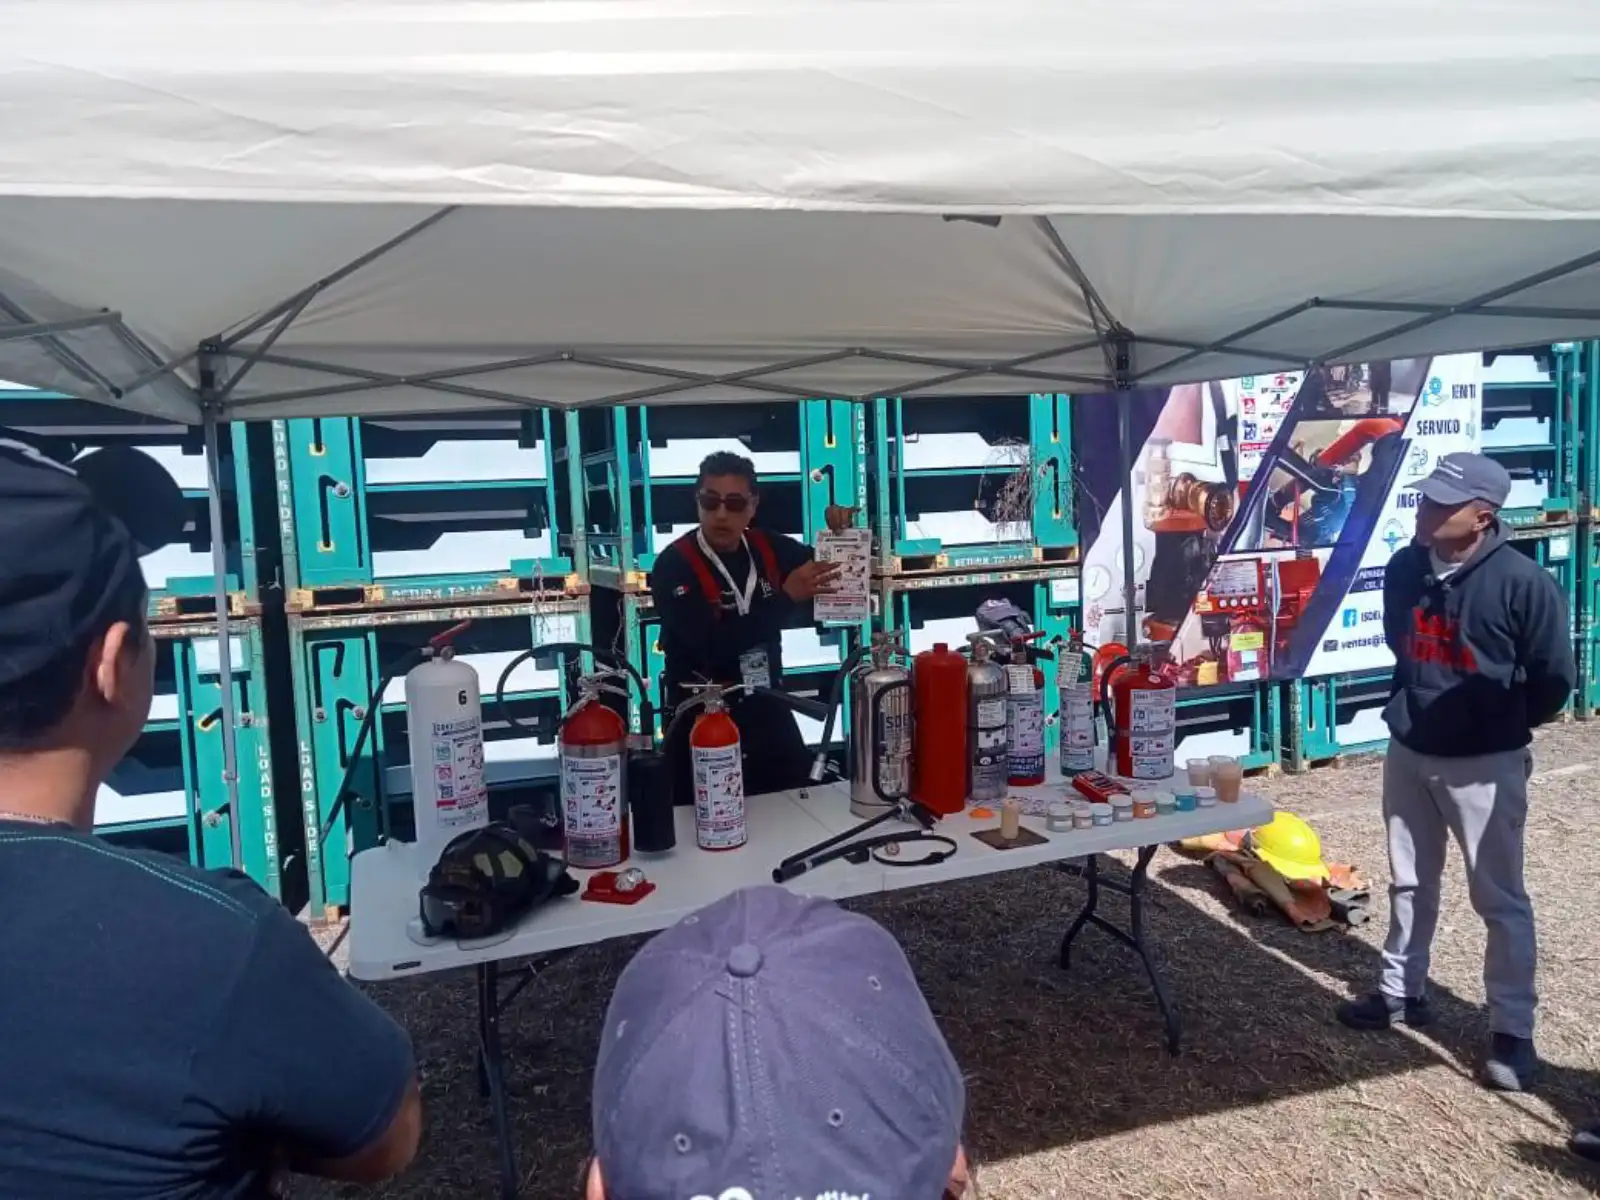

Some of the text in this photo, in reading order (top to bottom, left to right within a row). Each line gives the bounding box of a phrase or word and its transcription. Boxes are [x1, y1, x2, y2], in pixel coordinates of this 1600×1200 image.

[272, 419, 293, 533] LOAD SIDE
[458, 690, 467, 705] 6
[259, 745, 277, 857] LOAD SIDE
[301, 740, 318, 852] LOAD SIDE
